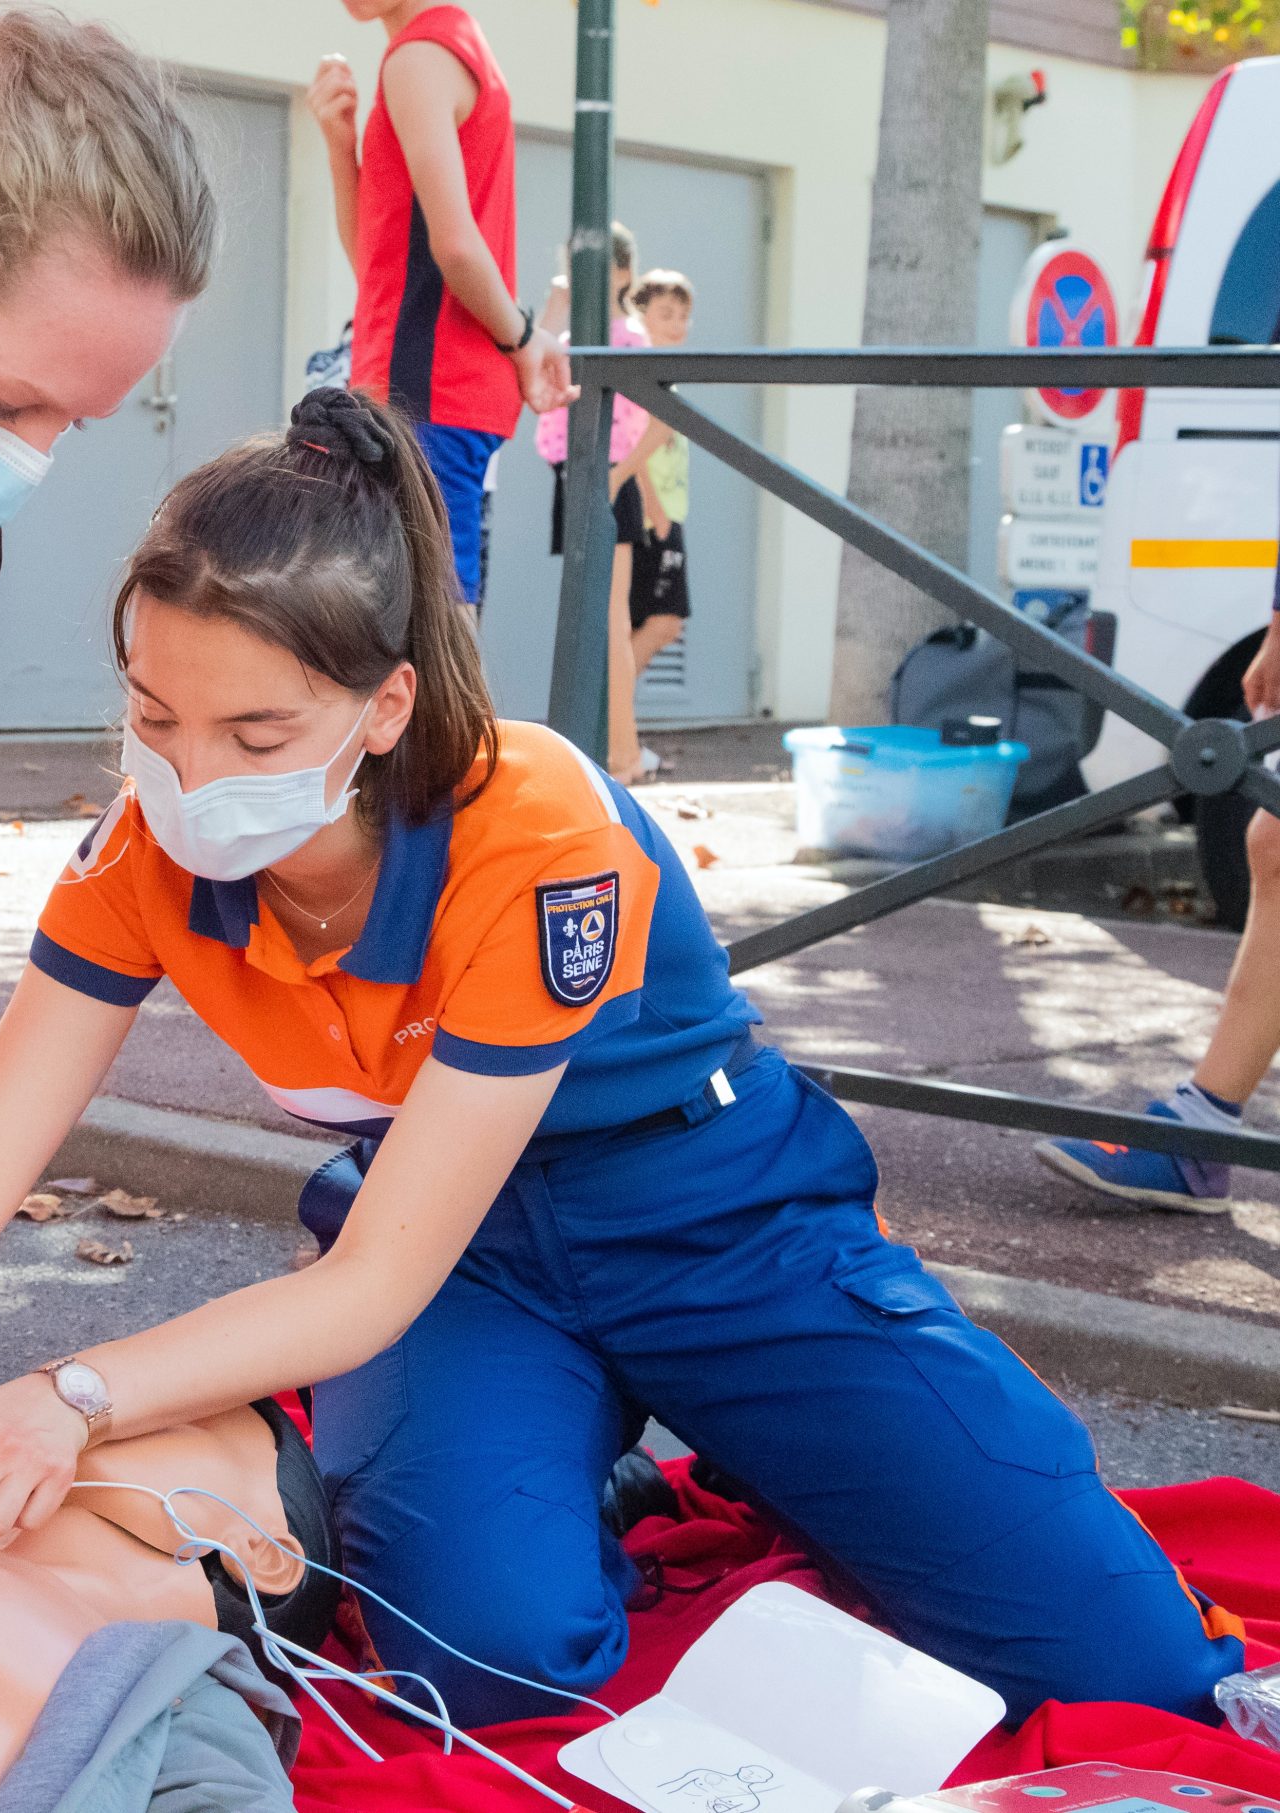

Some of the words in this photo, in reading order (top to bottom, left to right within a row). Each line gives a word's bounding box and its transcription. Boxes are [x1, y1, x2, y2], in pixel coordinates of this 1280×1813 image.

[547, 899, 595, 915] PROTECTION
[563, 935, 605, 964] PARIS
[562, 954, 604, 979] SEINE
